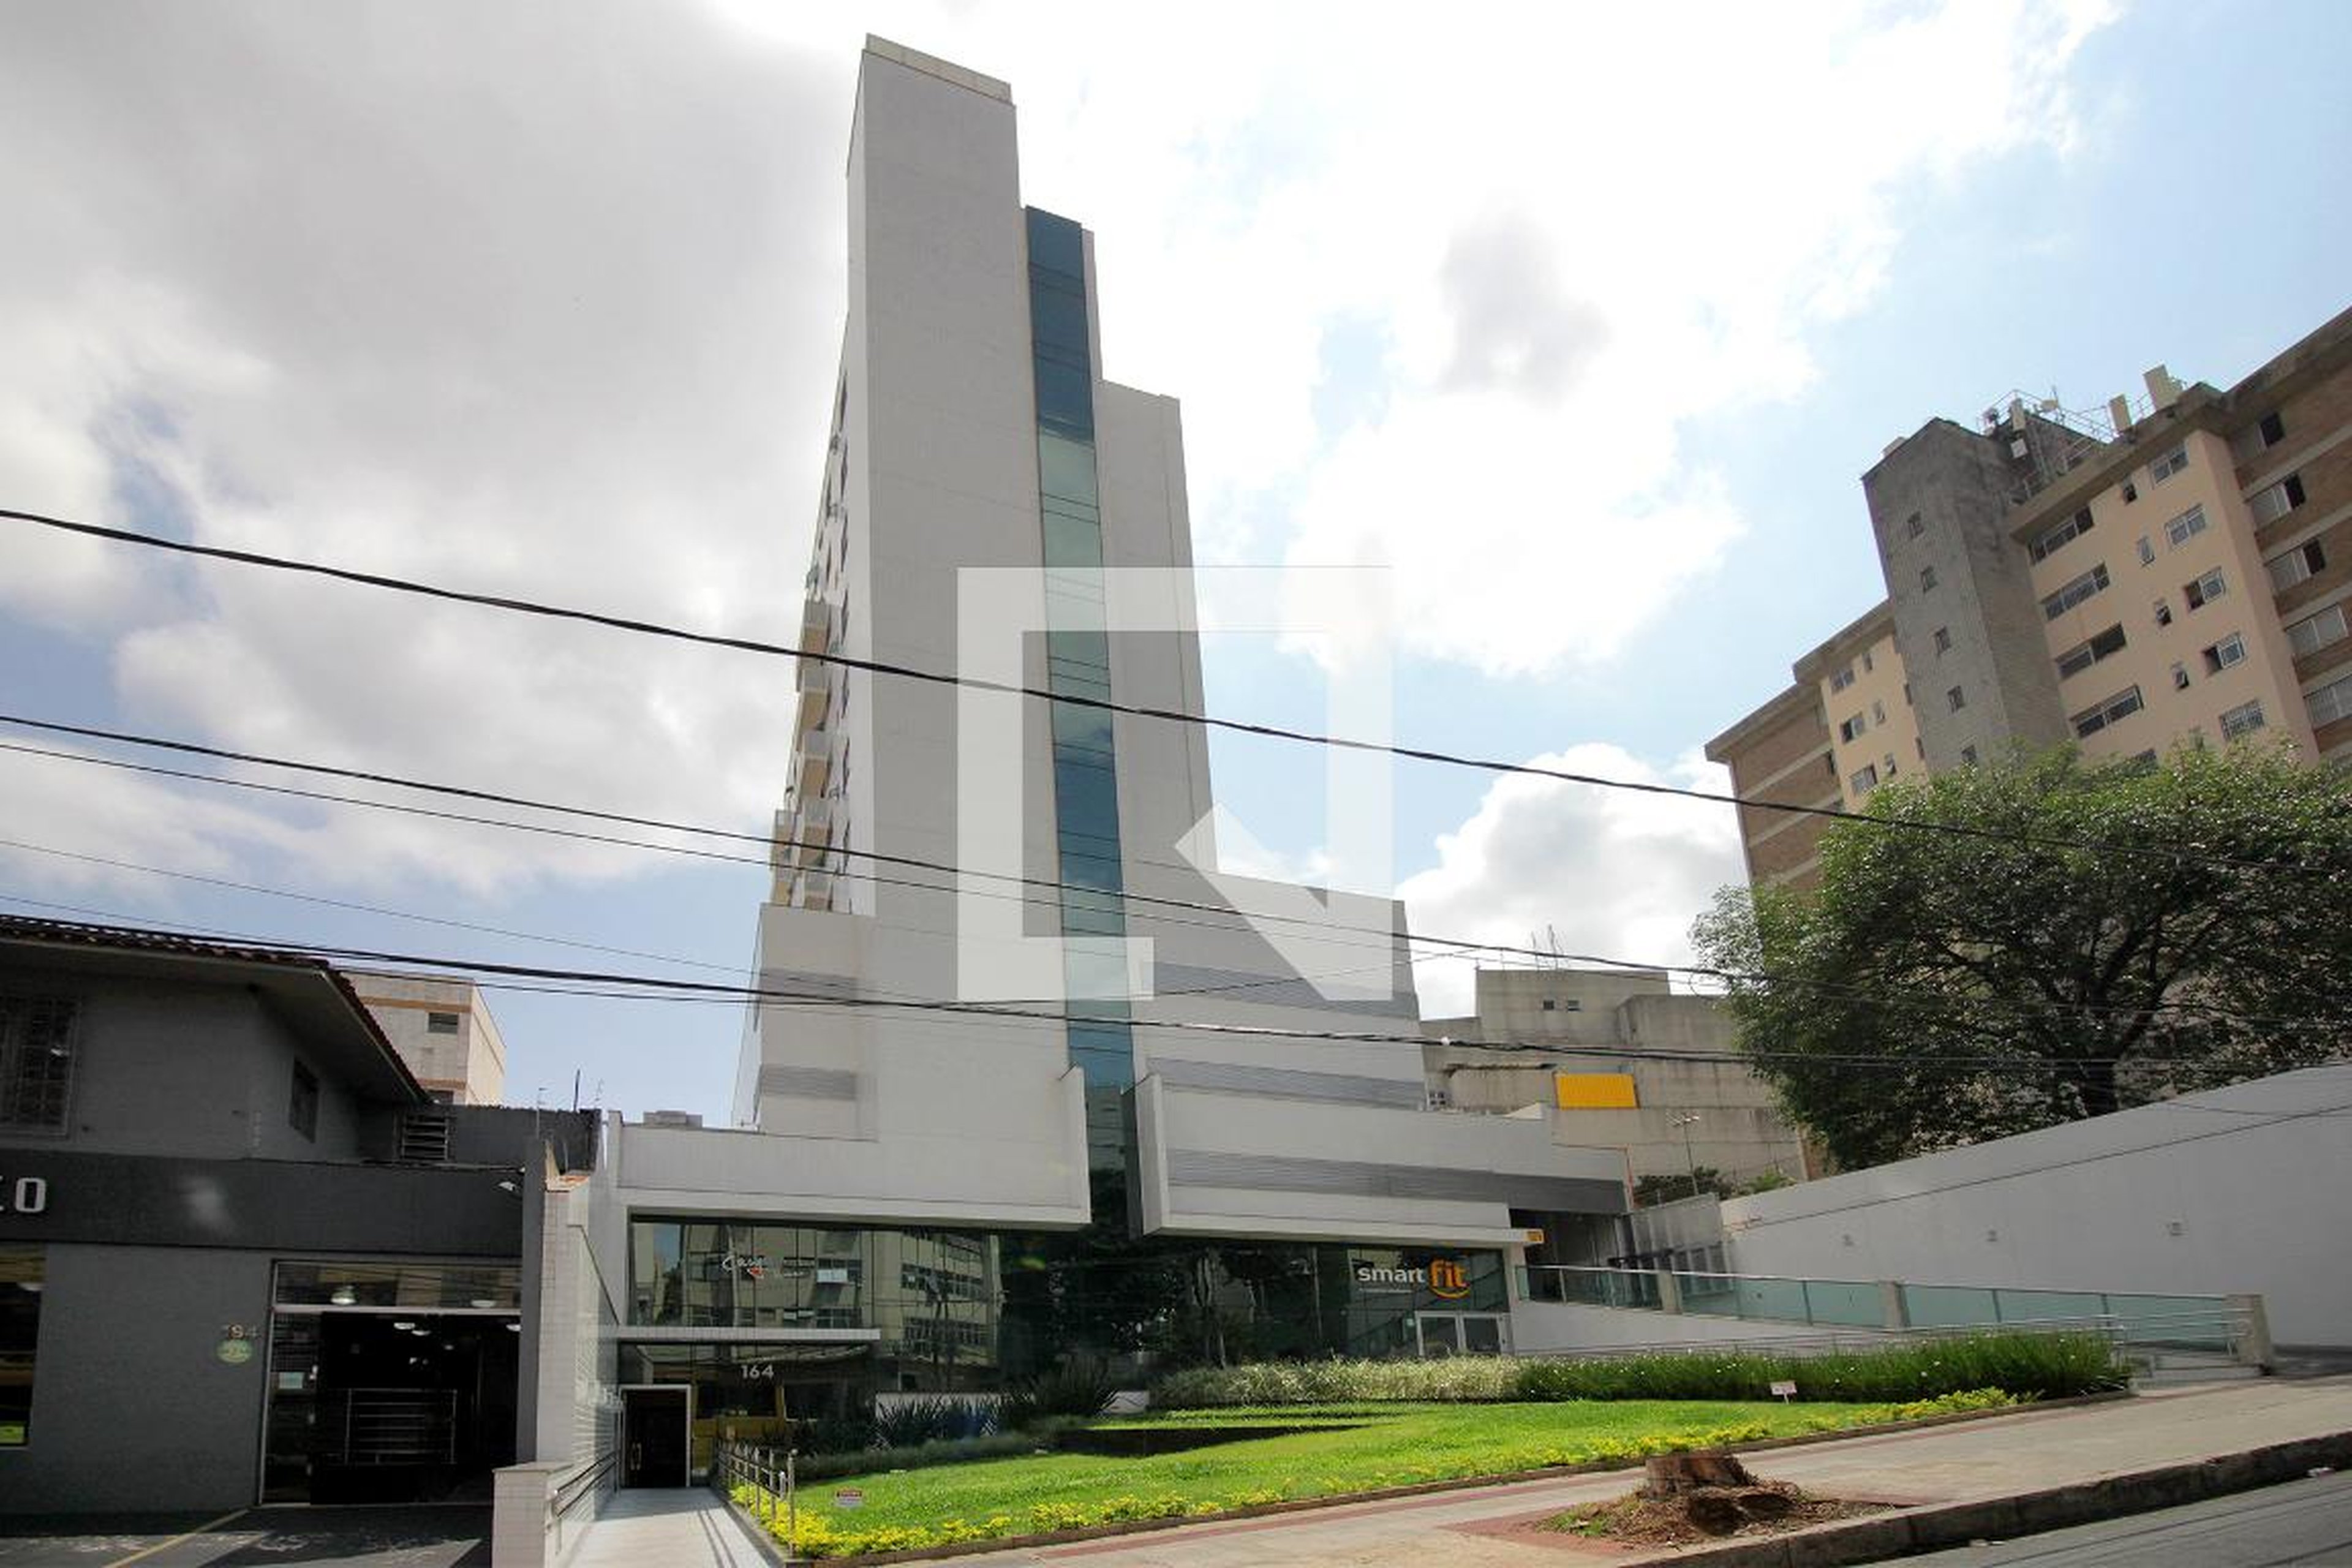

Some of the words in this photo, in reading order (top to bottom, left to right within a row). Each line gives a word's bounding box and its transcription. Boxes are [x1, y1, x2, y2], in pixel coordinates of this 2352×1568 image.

[0, 1175, 46, 1213] O
[1357, 1267, 1426, 1283] smart
[1430, 1259, 1469, 1287] fit
[741, 1364, 775, 1379] 164
